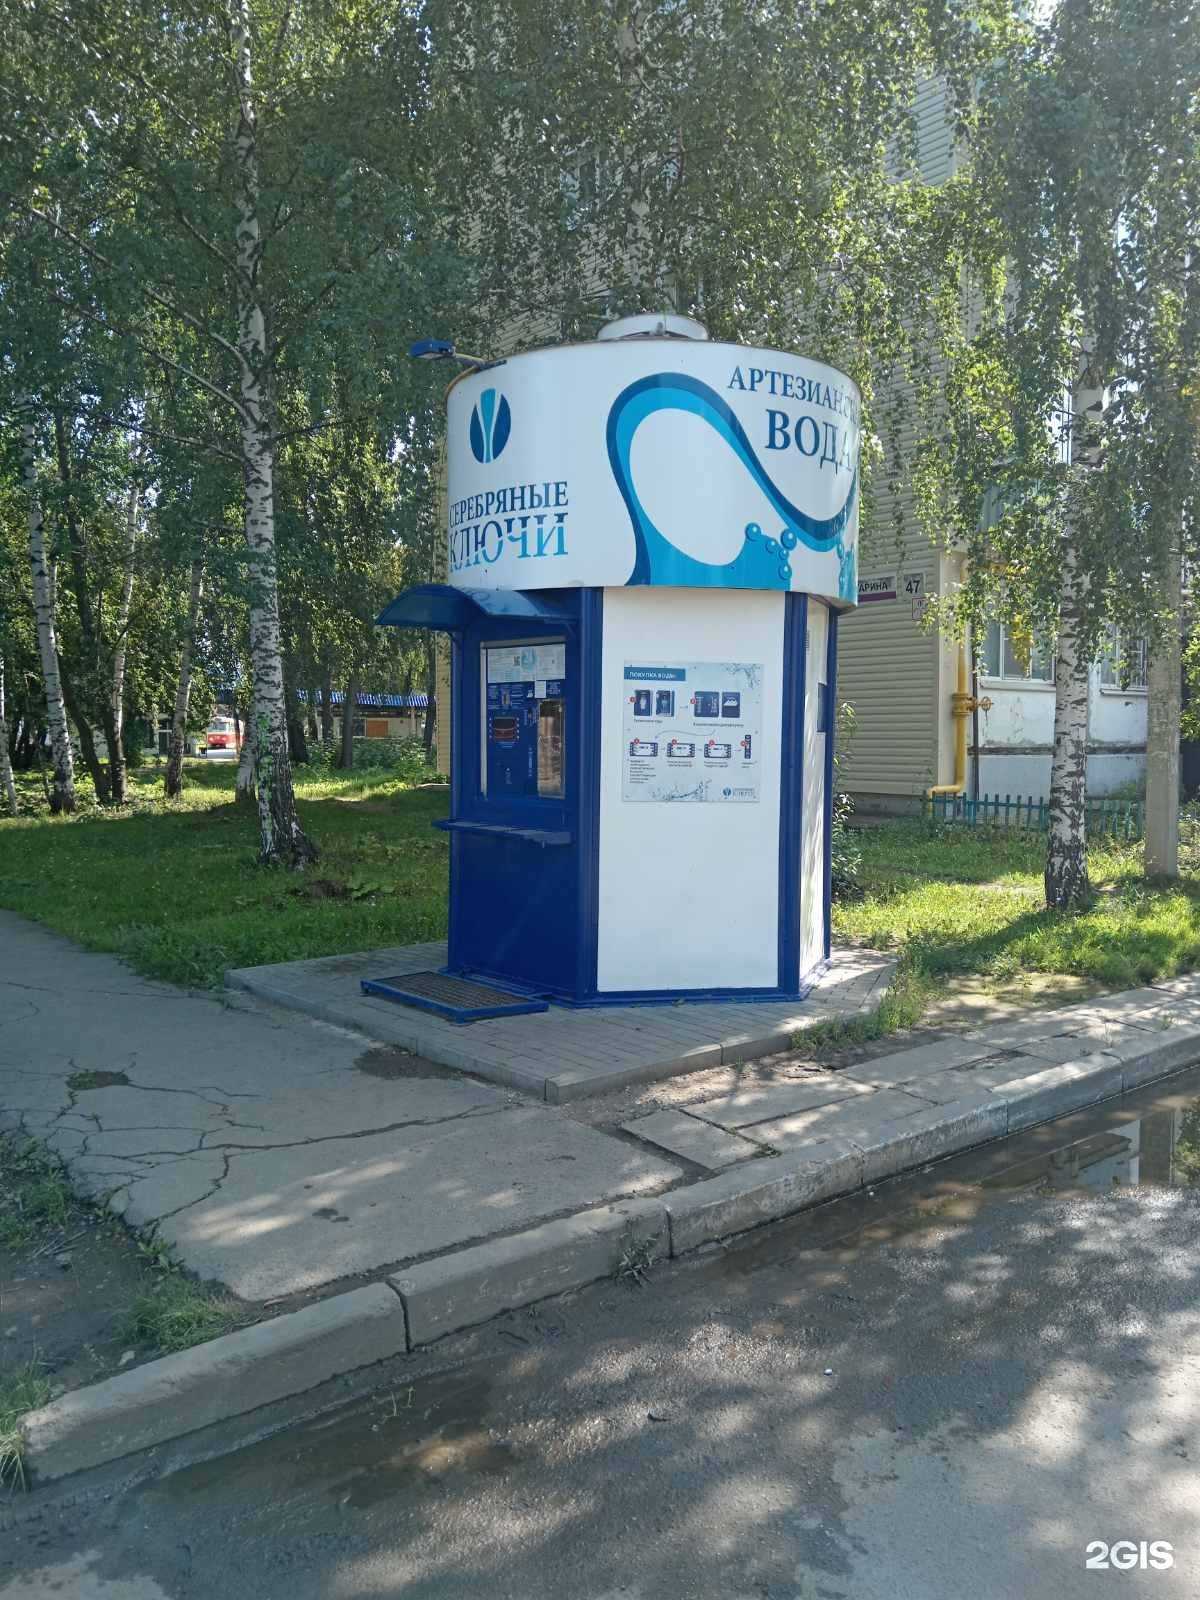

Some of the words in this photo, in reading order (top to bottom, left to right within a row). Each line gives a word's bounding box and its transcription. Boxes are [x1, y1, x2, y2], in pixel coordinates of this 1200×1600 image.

[449, 481, 569, 528] СЕРЕБРЯНЫЕ
[449, 512, 569, 573] КЛЮЧИ
[858, 581, 888, 593] АРИНА
[905, 580, 920, 594] 47
